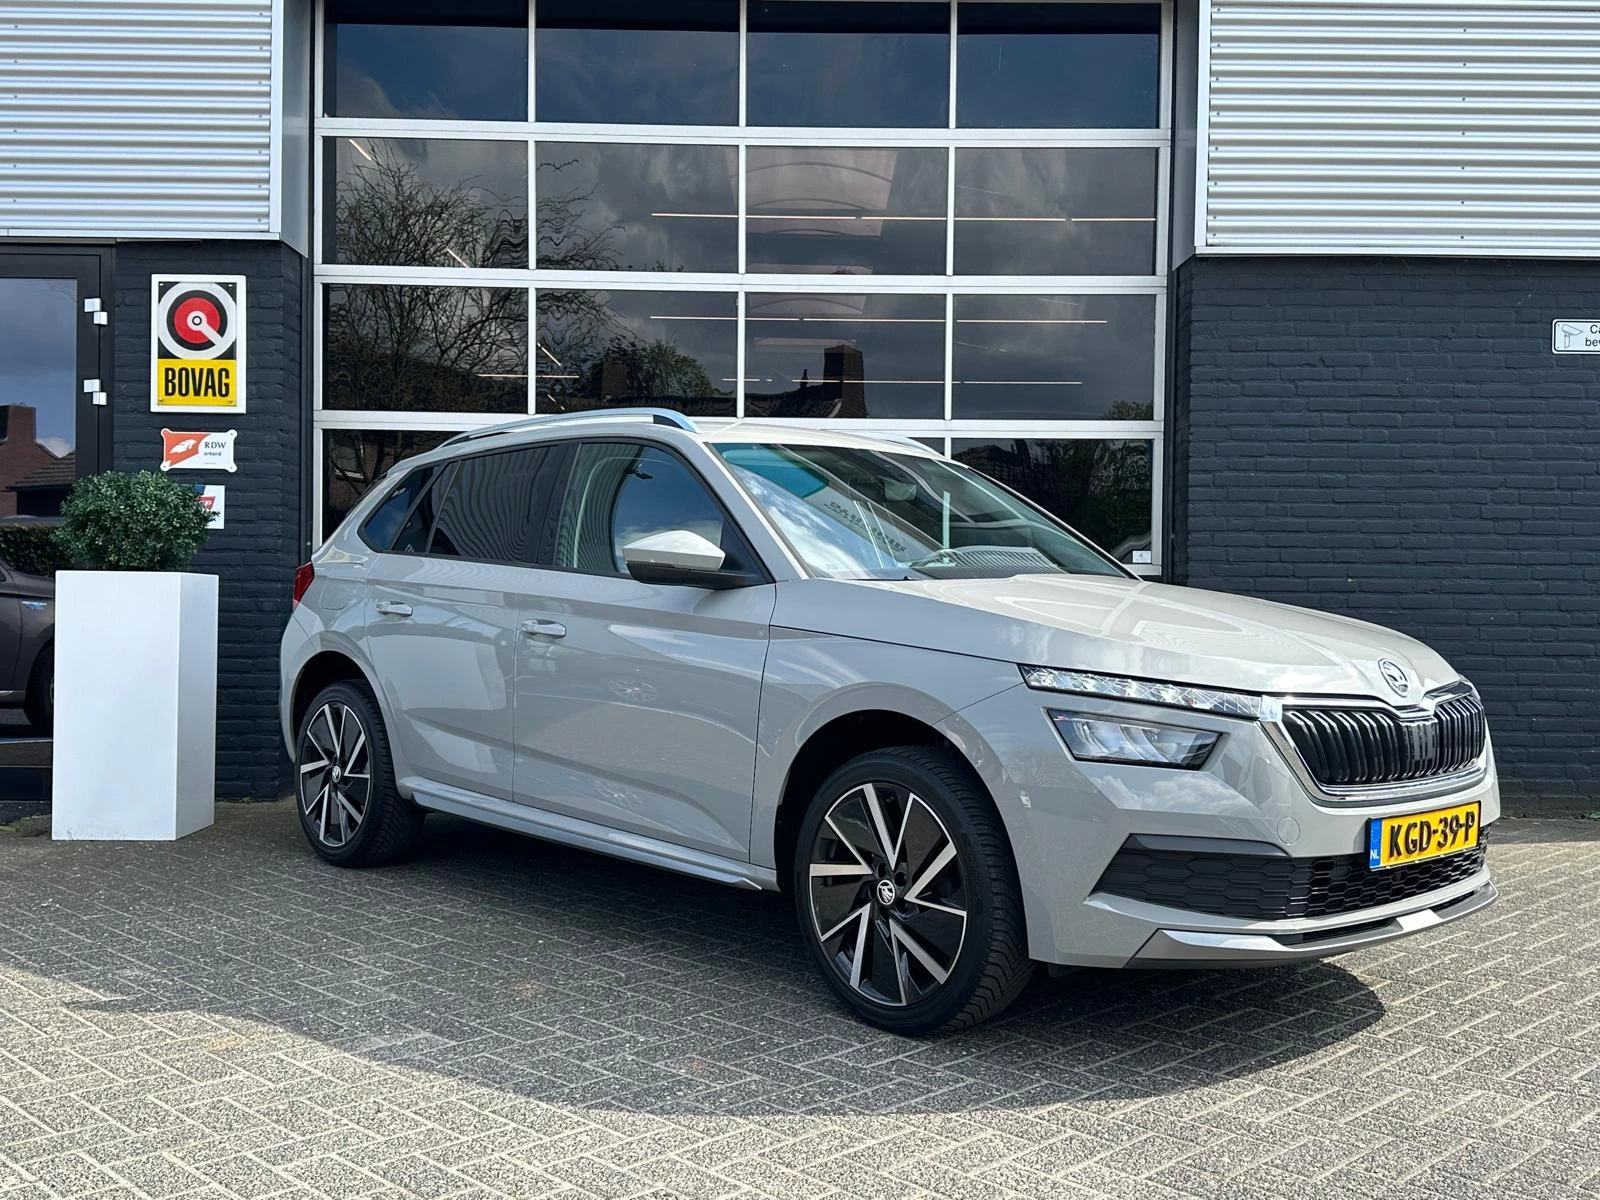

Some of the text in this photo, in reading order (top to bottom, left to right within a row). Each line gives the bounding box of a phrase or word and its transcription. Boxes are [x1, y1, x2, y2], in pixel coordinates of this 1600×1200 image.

[1590, 324, 1600, 334] C
[1585, 337, 1600, 347] be
[164, 367, 230, 397] BOVAG
[204, 441, 227, 449] RDW
[1389, 811, 1475, 858] KGD-39-P
[1370, 849, 1380, 860] NL
